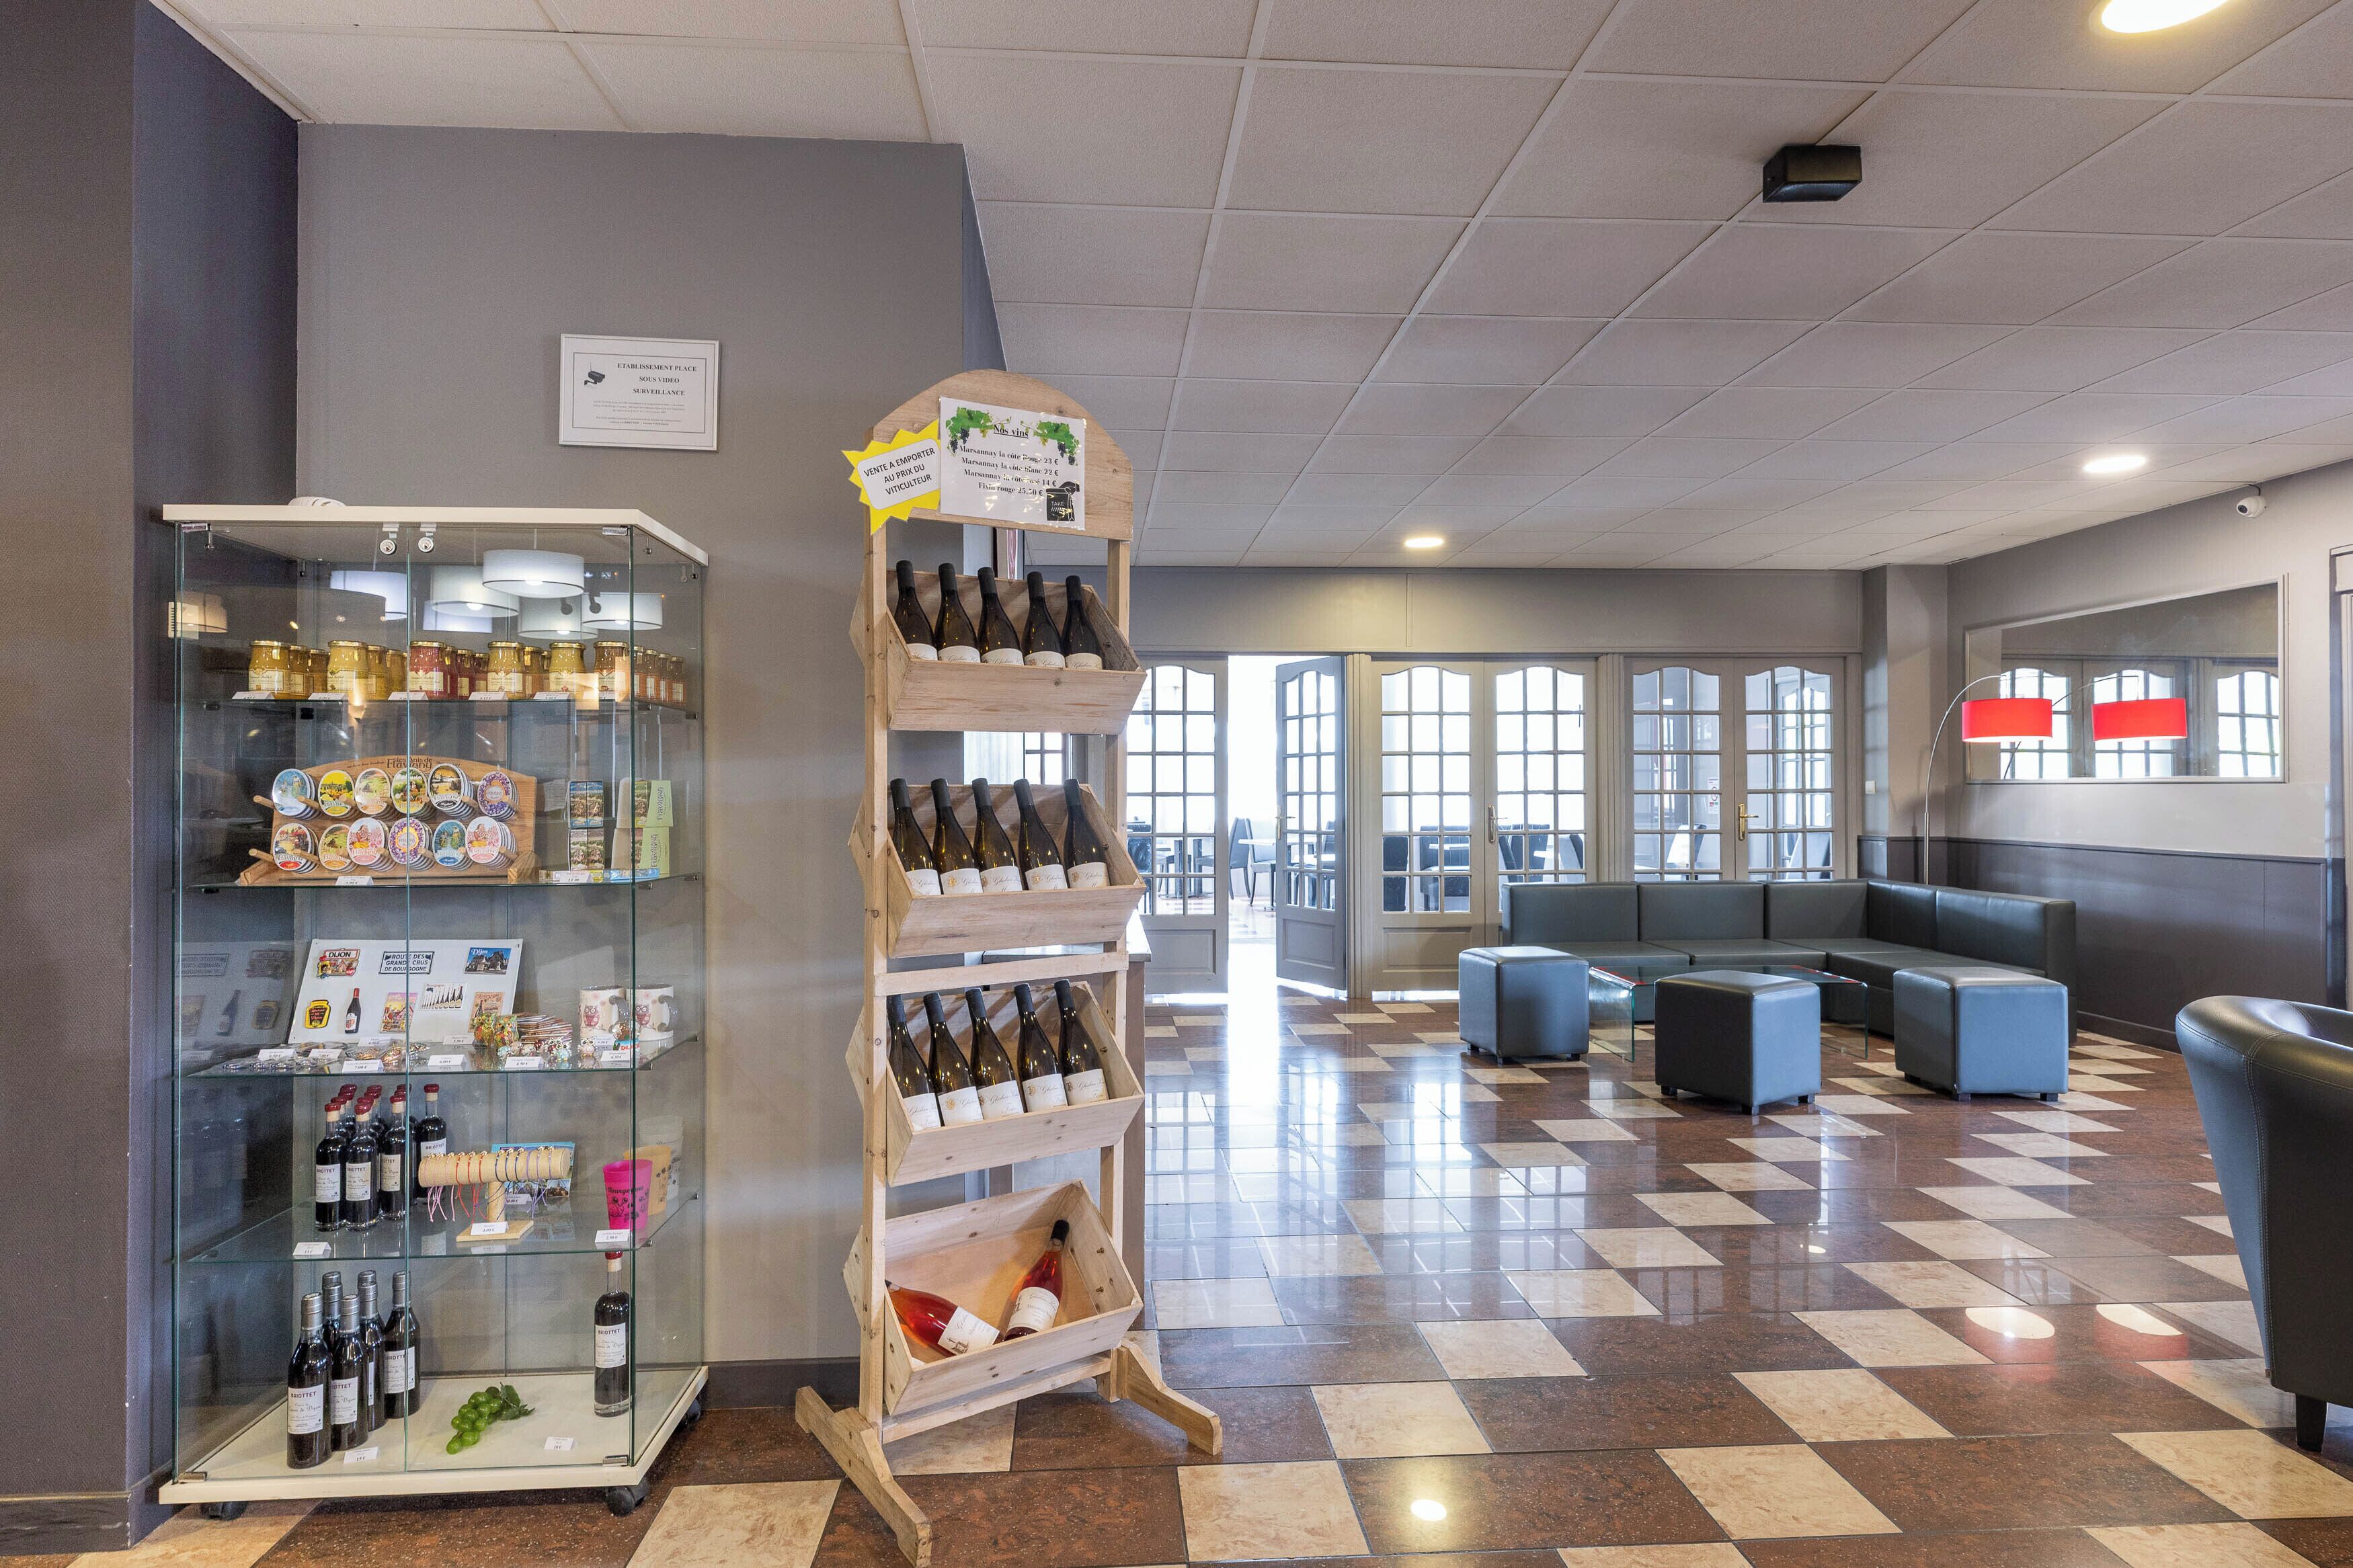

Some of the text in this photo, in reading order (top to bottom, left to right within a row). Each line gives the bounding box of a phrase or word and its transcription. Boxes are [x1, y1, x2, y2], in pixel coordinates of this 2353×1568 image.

[618, 362, 674, 371] ETABLISSEMENT
[994, 425, 1029, 437] Nos vins
[960, 445, 998, 458] Marsannay
[864, 464, 888, 477] VENTE
[895, 448, 935, 466] EMPORTER
[962, 456, 999, 470] Marsannay
[884, 463, 925, 483] AU PRIX DU
[964, 468, 1001, 481] Marsannay
[885, 474, 932, 495] VITICULTEUR
[979, 482, 996, 491] Fixin
[997, 486, 1016, 495] rouge
[1018, 487, 1037, 496] 25.50
[290, 1391, 317, 1399] BRIOTTET
